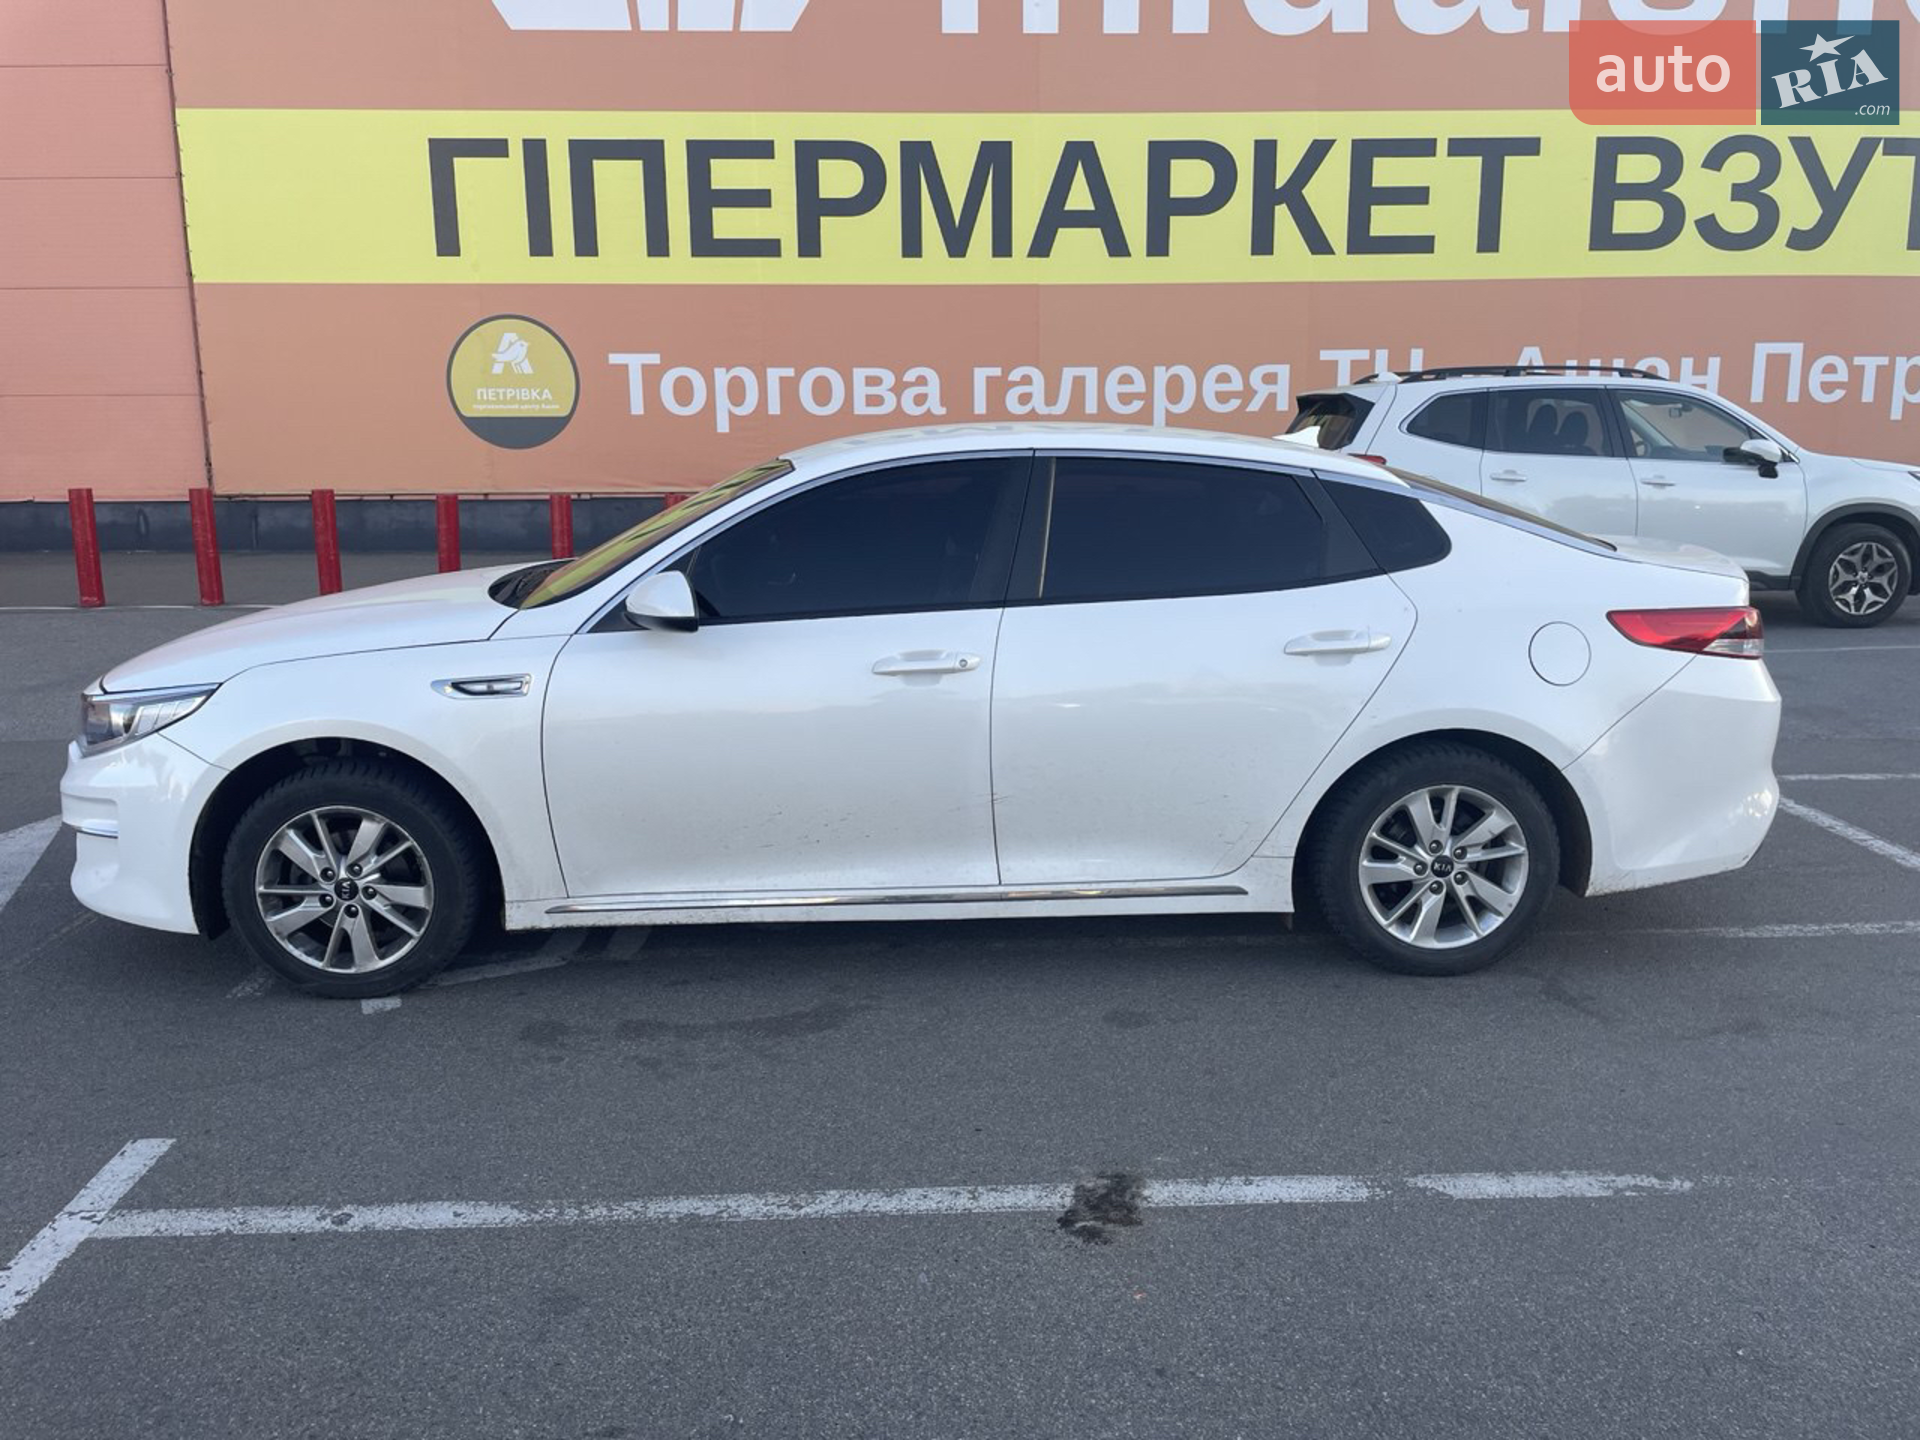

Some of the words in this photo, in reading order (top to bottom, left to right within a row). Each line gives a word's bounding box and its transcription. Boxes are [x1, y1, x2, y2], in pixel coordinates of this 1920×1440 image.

[428, 137, 1542, 259] ГІПЕРМАРКЕТ
[476, 387, 553, 401] ПЕТРІВКА
[608, 353, 947, 433] Торгова
[972, 363, 1291, 427] галерея
[1433, 862, 1452, 872] KIA
[341, 881, 351, 899] KIA
